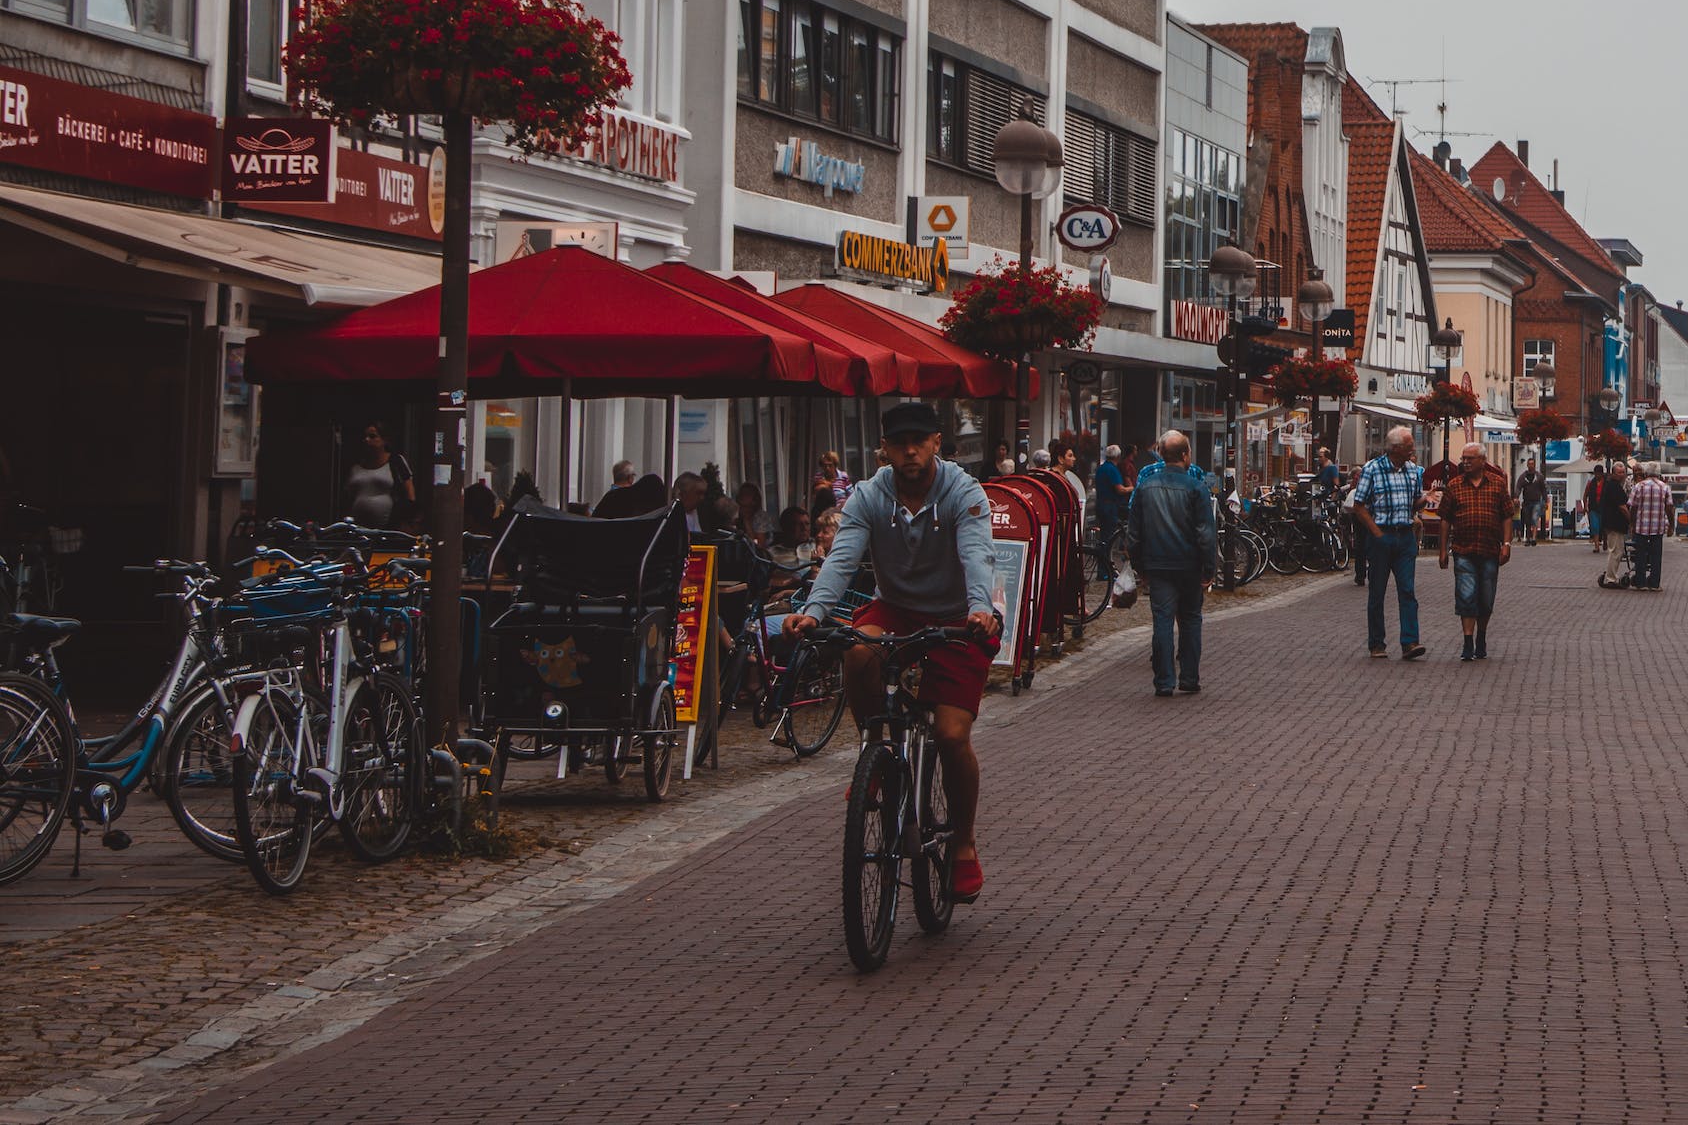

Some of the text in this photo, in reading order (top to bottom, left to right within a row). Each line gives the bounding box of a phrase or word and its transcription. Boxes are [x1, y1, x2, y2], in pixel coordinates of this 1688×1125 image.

[58, 115, 208, 164] BÄCKEREI CAFÉ KONDITOREI
[230, 154, 320, 175] VATTER
[378, 168, 414, 206] VATTER
[1067, 218, 1107, 239] C&A
[843, 230, 933, 282] COMMERZBANK
[991, 513, 1010, 524] ER
[169, 677, 185, 704] EURO
